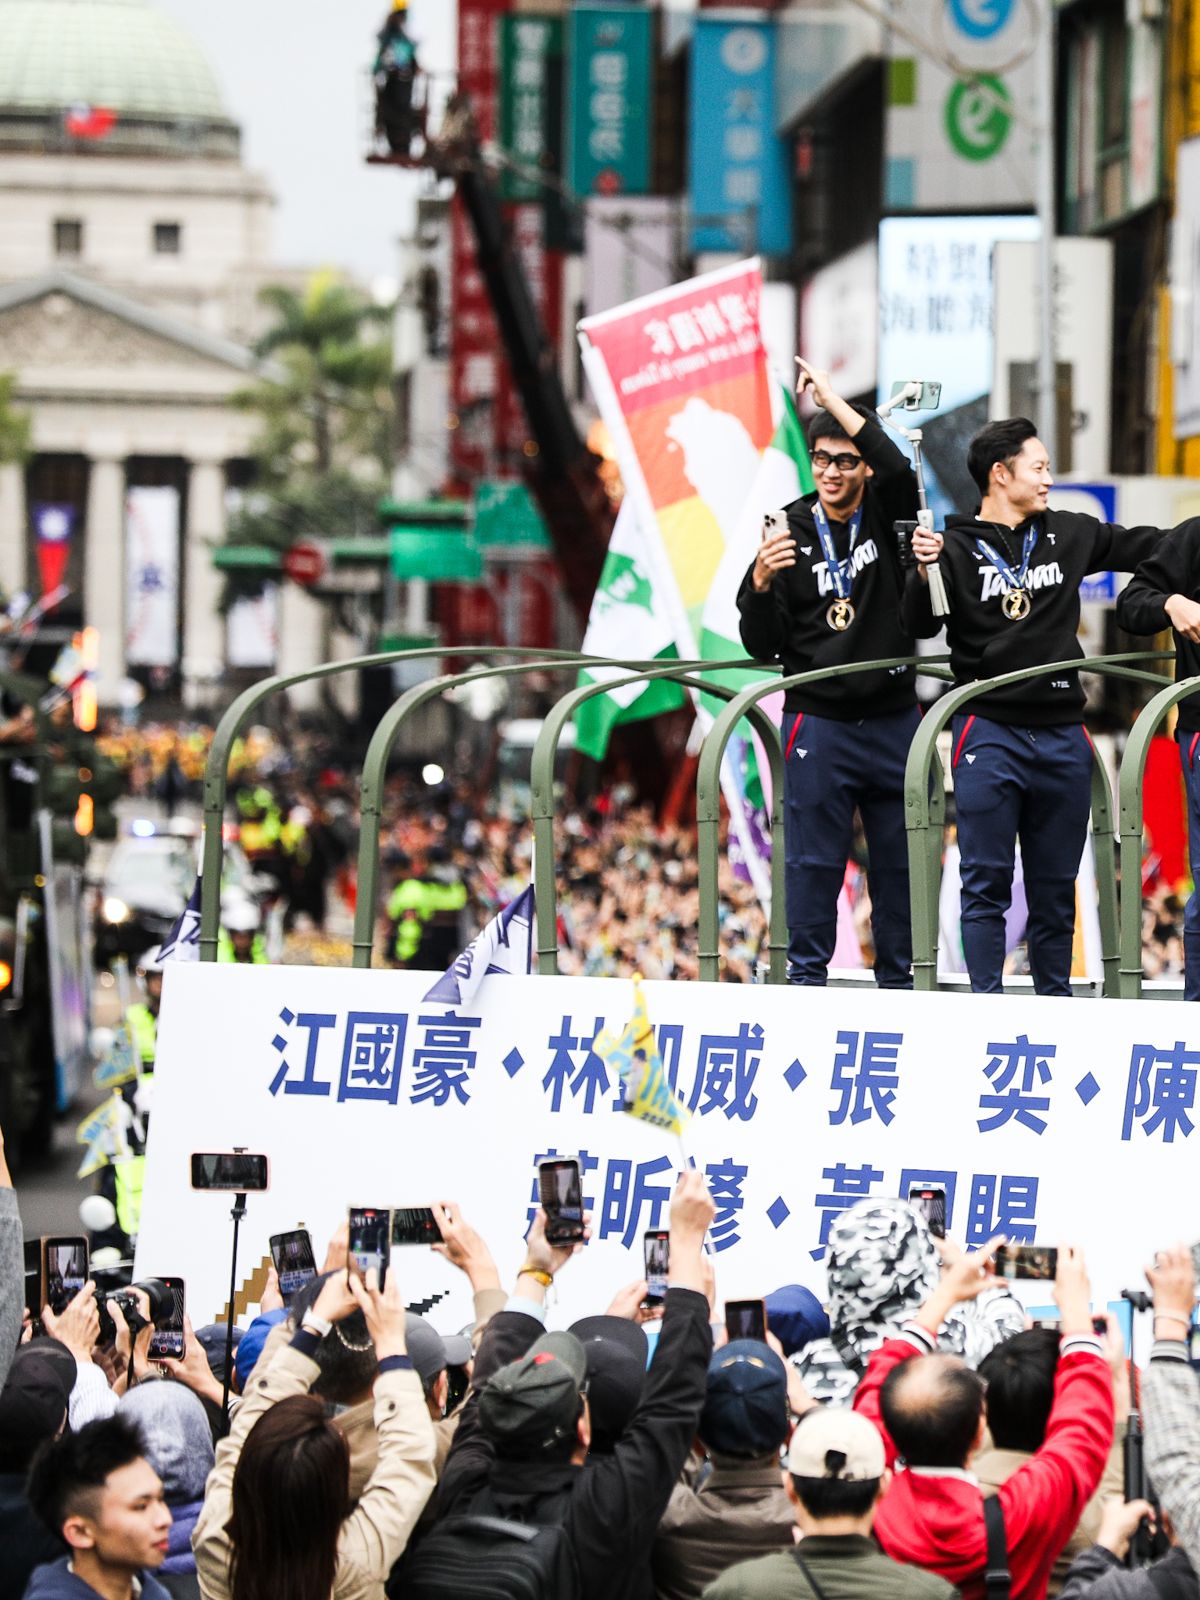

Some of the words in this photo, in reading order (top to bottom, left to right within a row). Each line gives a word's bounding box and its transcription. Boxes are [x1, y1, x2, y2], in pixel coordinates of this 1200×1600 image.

[978, 561, 1064, 603] Taan
[268, 1006, 482, 1107] 江國豪
[828, 1030, 904, 1128] 張
[976, 1034, 1058, 1136] 奕
